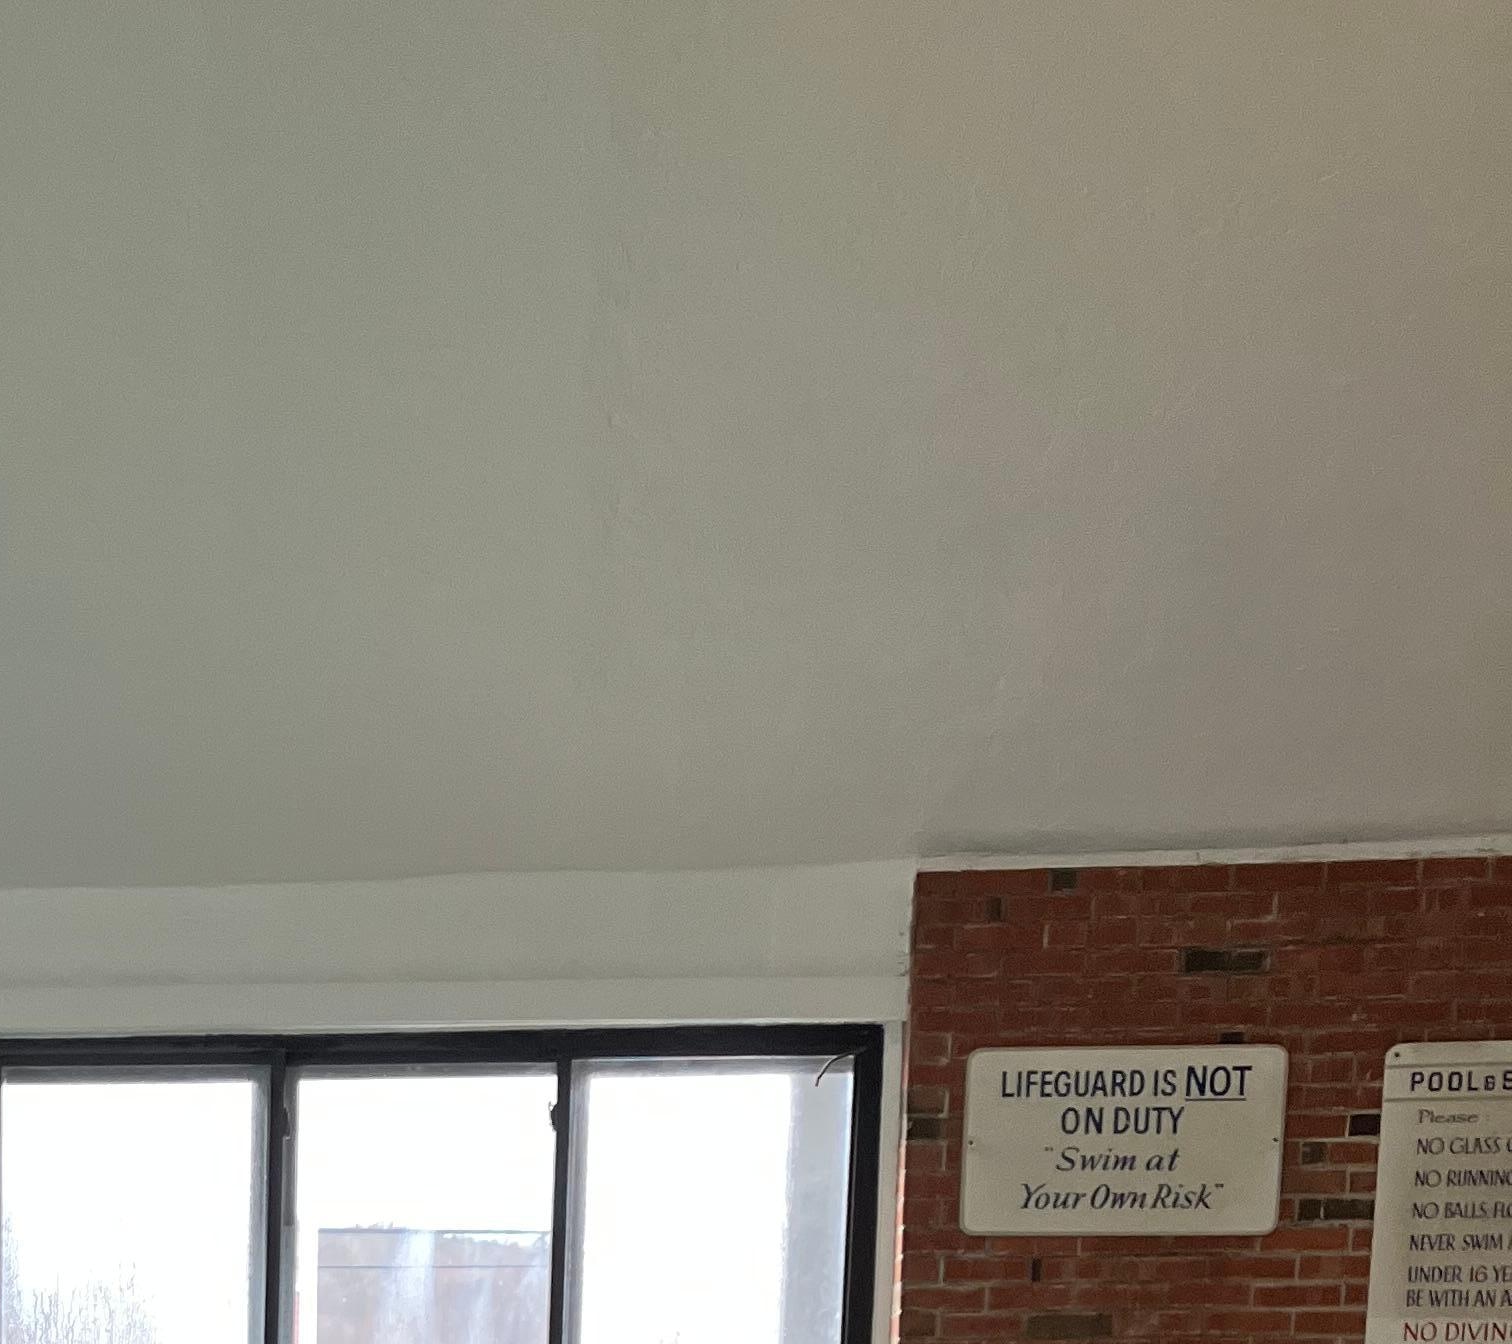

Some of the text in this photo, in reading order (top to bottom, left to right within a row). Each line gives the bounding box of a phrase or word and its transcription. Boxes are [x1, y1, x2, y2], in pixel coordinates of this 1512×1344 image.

[1000, 1064, 1253, 1098] LIFEGUARD IS NOT
[1409, 1070, 1479, 1092] POOL
[1061, 1106, 1186, 1135] ON DUTY
[1416, 1137, 1445, 1155] NO
[1449, 1136, 1502, 1155] GLASS
[1145, 1148, 1180, 1172] at
[1414, 1169, 1442, 1188] NO
[1019, 1182, 1087, 1210] Your
[1089, 1182, 1148, 1210] Own
[1412, 1202, 1439, 1219] NO
[1444, 1201, 1488, 1219] BALLS
[1408, 1234, 1456, 1251] NEVER
[1462, 1233, 1503, 1251] SWIM
[1407, 1265, 1463, 1283] UNDER
[1469, 1265, 1487, 1283] 16
[1406, 1289, 1424, 1307] BE
[1430, 1289, 1470, 1307] WITH
[1473, 1289, 1497, 1307] AN
[1403, 1321, 1512, 1342] NO DIVIN
